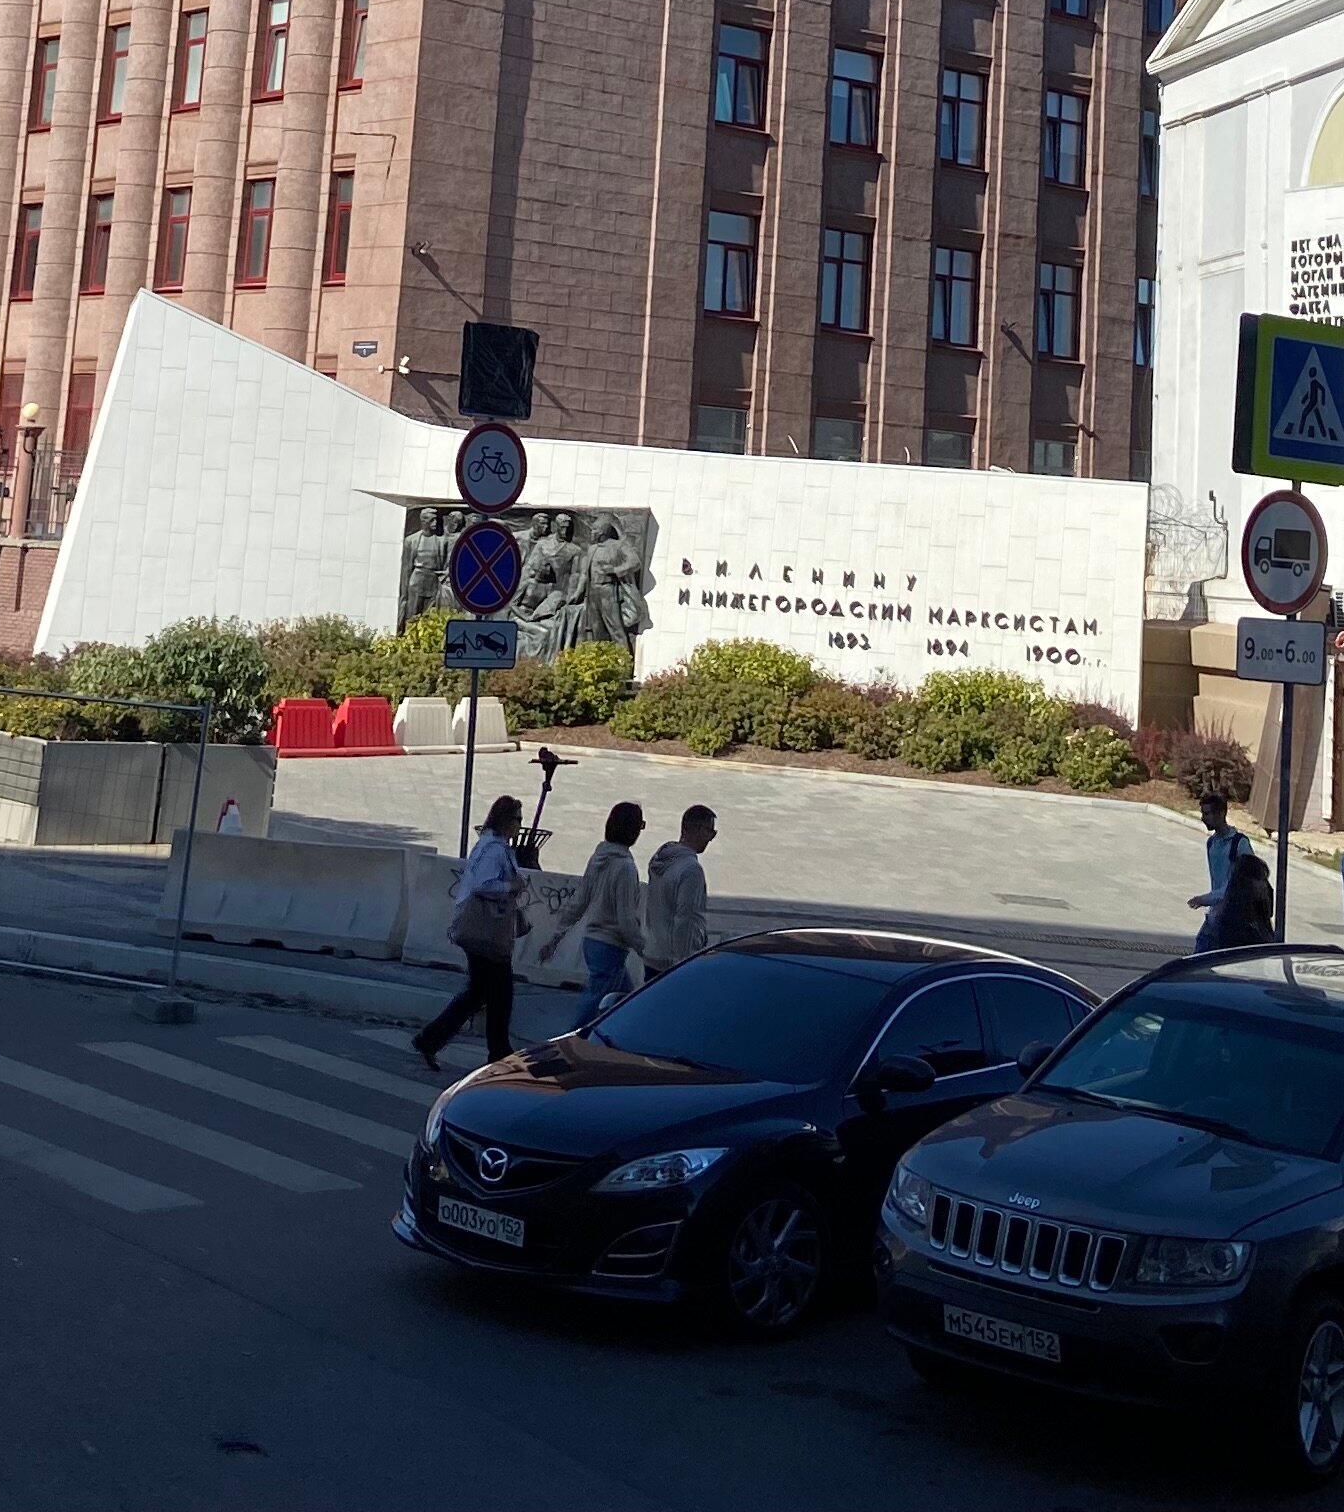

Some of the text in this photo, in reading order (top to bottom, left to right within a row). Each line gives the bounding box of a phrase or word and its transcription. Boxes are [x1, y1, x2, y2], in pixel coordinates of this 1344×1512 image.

[1291, 238, 1311, 253] НЕТ
[749, 562, 917, 592] ЛЕНИНУ
[678, 587, 691, 606] И
[701, 590, 912, 623] НИЖЕГОРОДСКИМ
[1008, 1191, 1042, 1210] Jeep
[1026, 1329, 1057, 1353] 152
